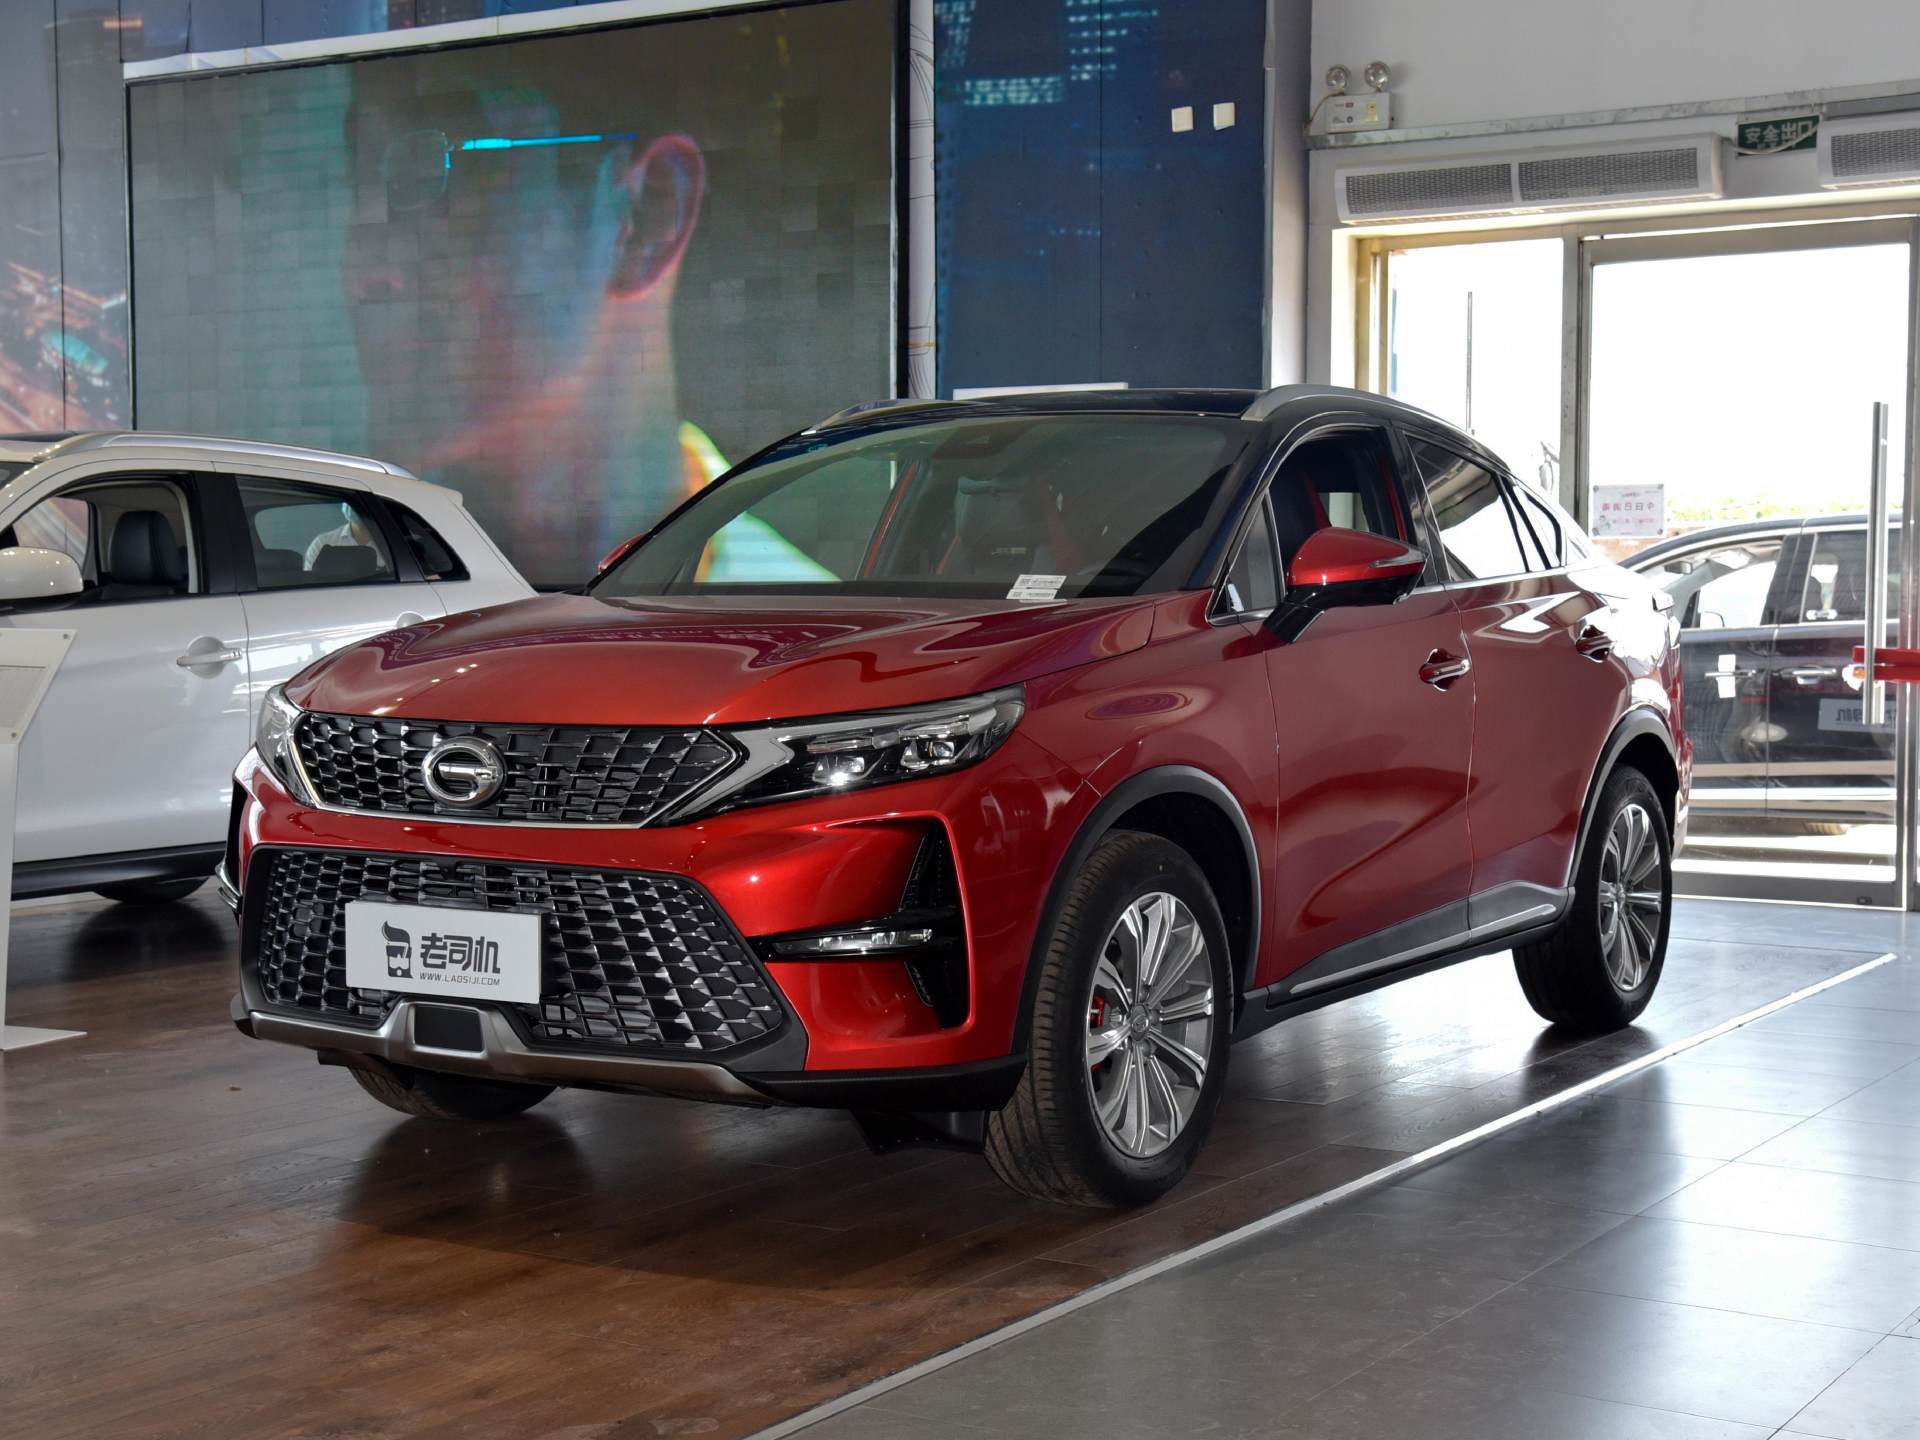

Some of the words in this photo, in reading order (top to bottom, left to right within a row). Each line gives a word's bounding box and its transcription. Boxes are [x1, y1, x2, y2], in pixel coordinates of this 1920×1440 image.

[1745, 121, 1813, 144] 安全出口
[420, 933, 500, 974] 老司机
[419, 972, 500, 986] WWW.LAOSIJI.COM
